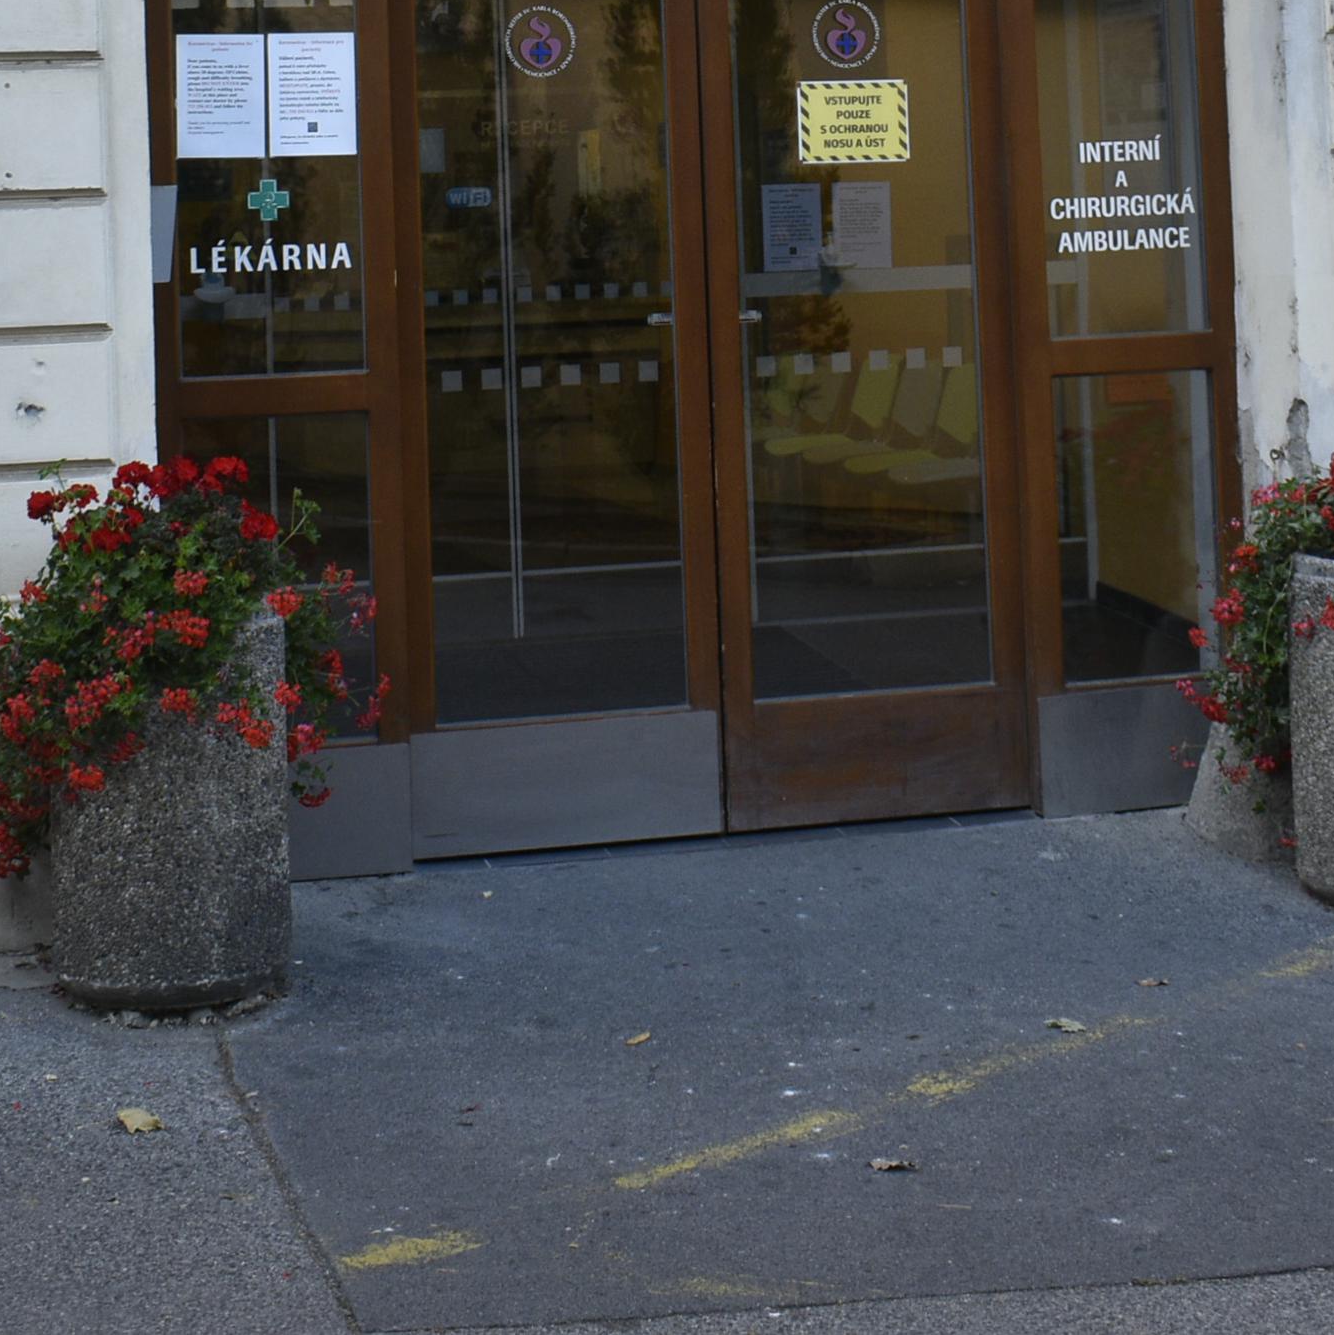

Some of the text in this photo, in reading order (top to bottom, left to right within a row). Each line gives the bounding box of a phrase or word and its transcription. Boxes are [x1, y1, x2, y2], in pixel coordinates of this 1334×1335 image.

[824, 95, 882, 106] VSTUPUJTE
[836, 110, 871, 120] POUZE
[481, 118, 569, 136] RCEPCE
[820, 124, 888, 134] S OCHRANOU
[824, 135, 886, 149] NOSU A ÚST
[1079, 134, 1161, 163] INTERNÍ
[1115, 170, 1128, 188] A
[1050, 187, 1195, 220] CHIRURGICKÁ
[1058, 227, 1191, 254] AMBULANCE
[190, 238, 352, 274] LÉKÁRNA
